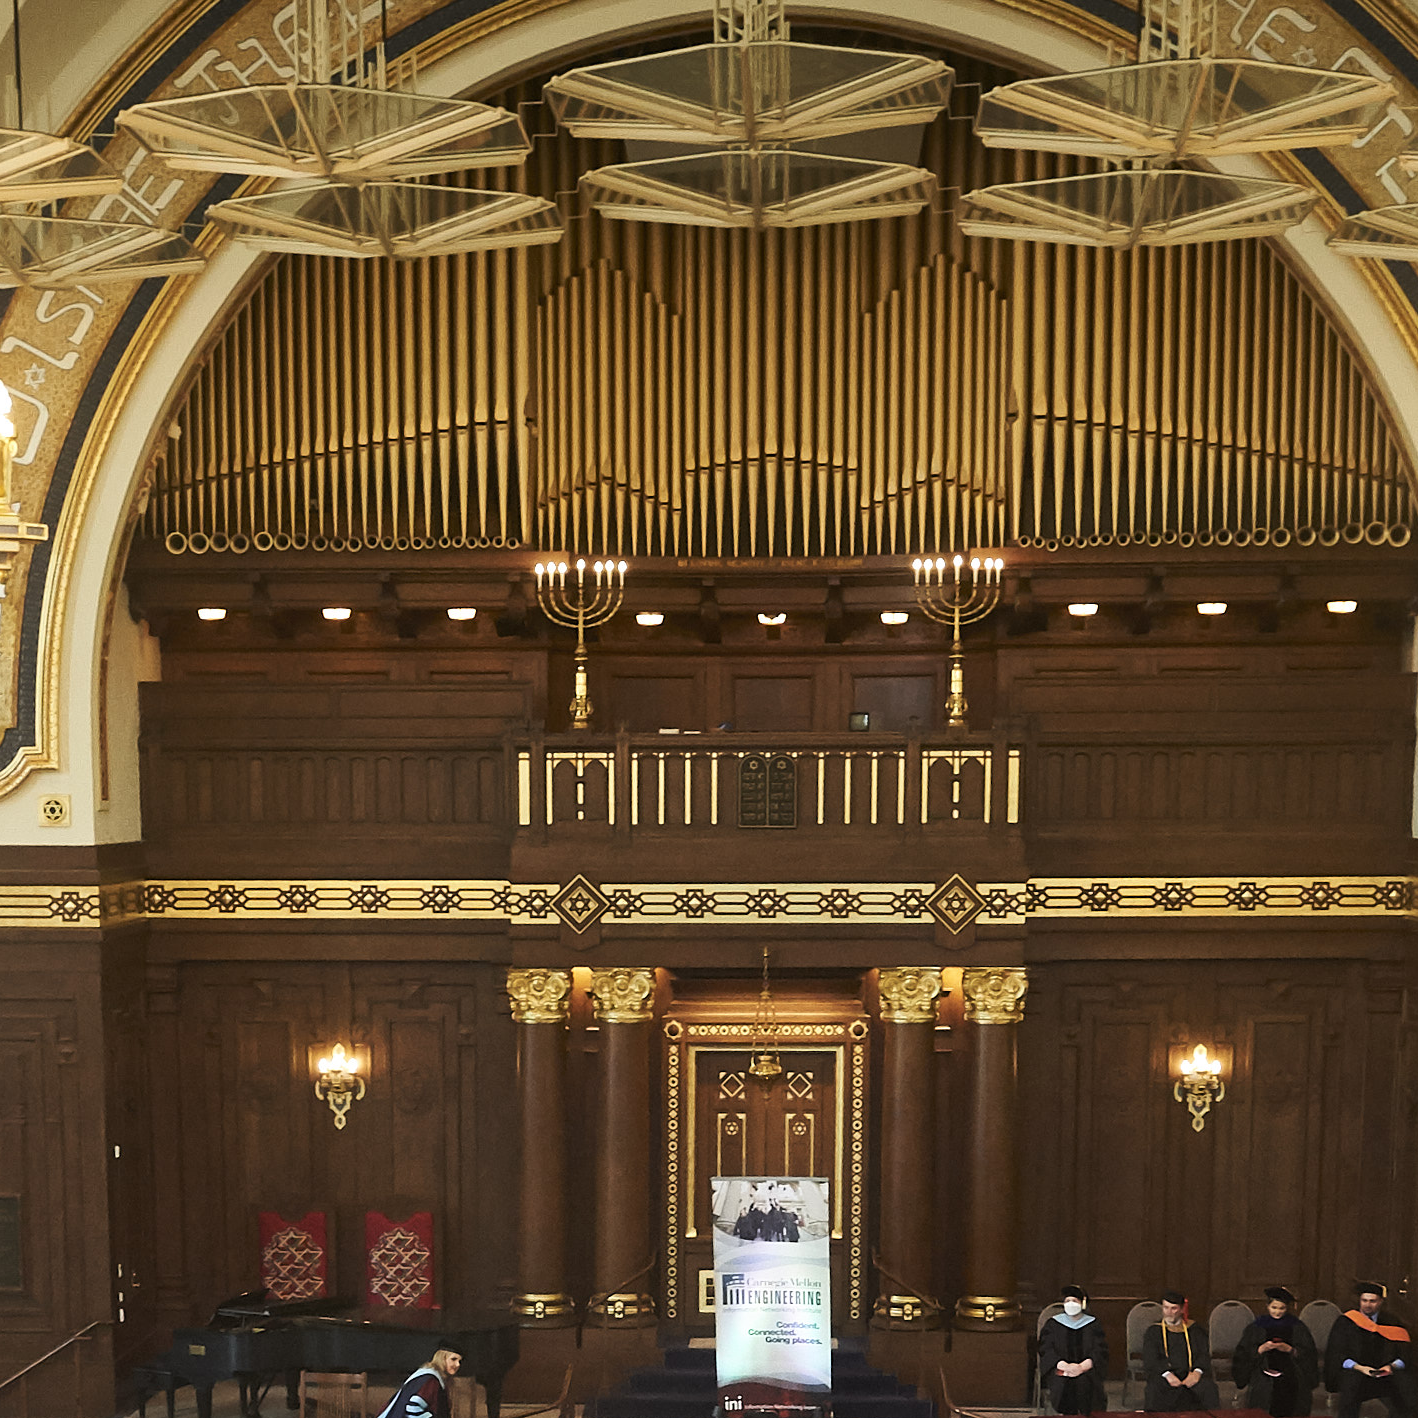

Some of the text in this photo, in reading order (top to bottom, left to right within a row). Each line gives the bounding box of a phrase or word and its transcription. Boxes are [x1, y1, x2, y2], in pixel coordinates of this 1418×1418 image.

[0, 146, 185, 370] ISAE
[746, 1277, 821, 1288] Carnegie Mellon
[748, 1290, 821, 1305] ENGINEERING
[776, 1321, 820, 1329] Confident.
[748, 1328, 796, 1336] Connected.
[765, 1336, 822, 1345] Going places.
[724, 1395, 743, 1411] ini
